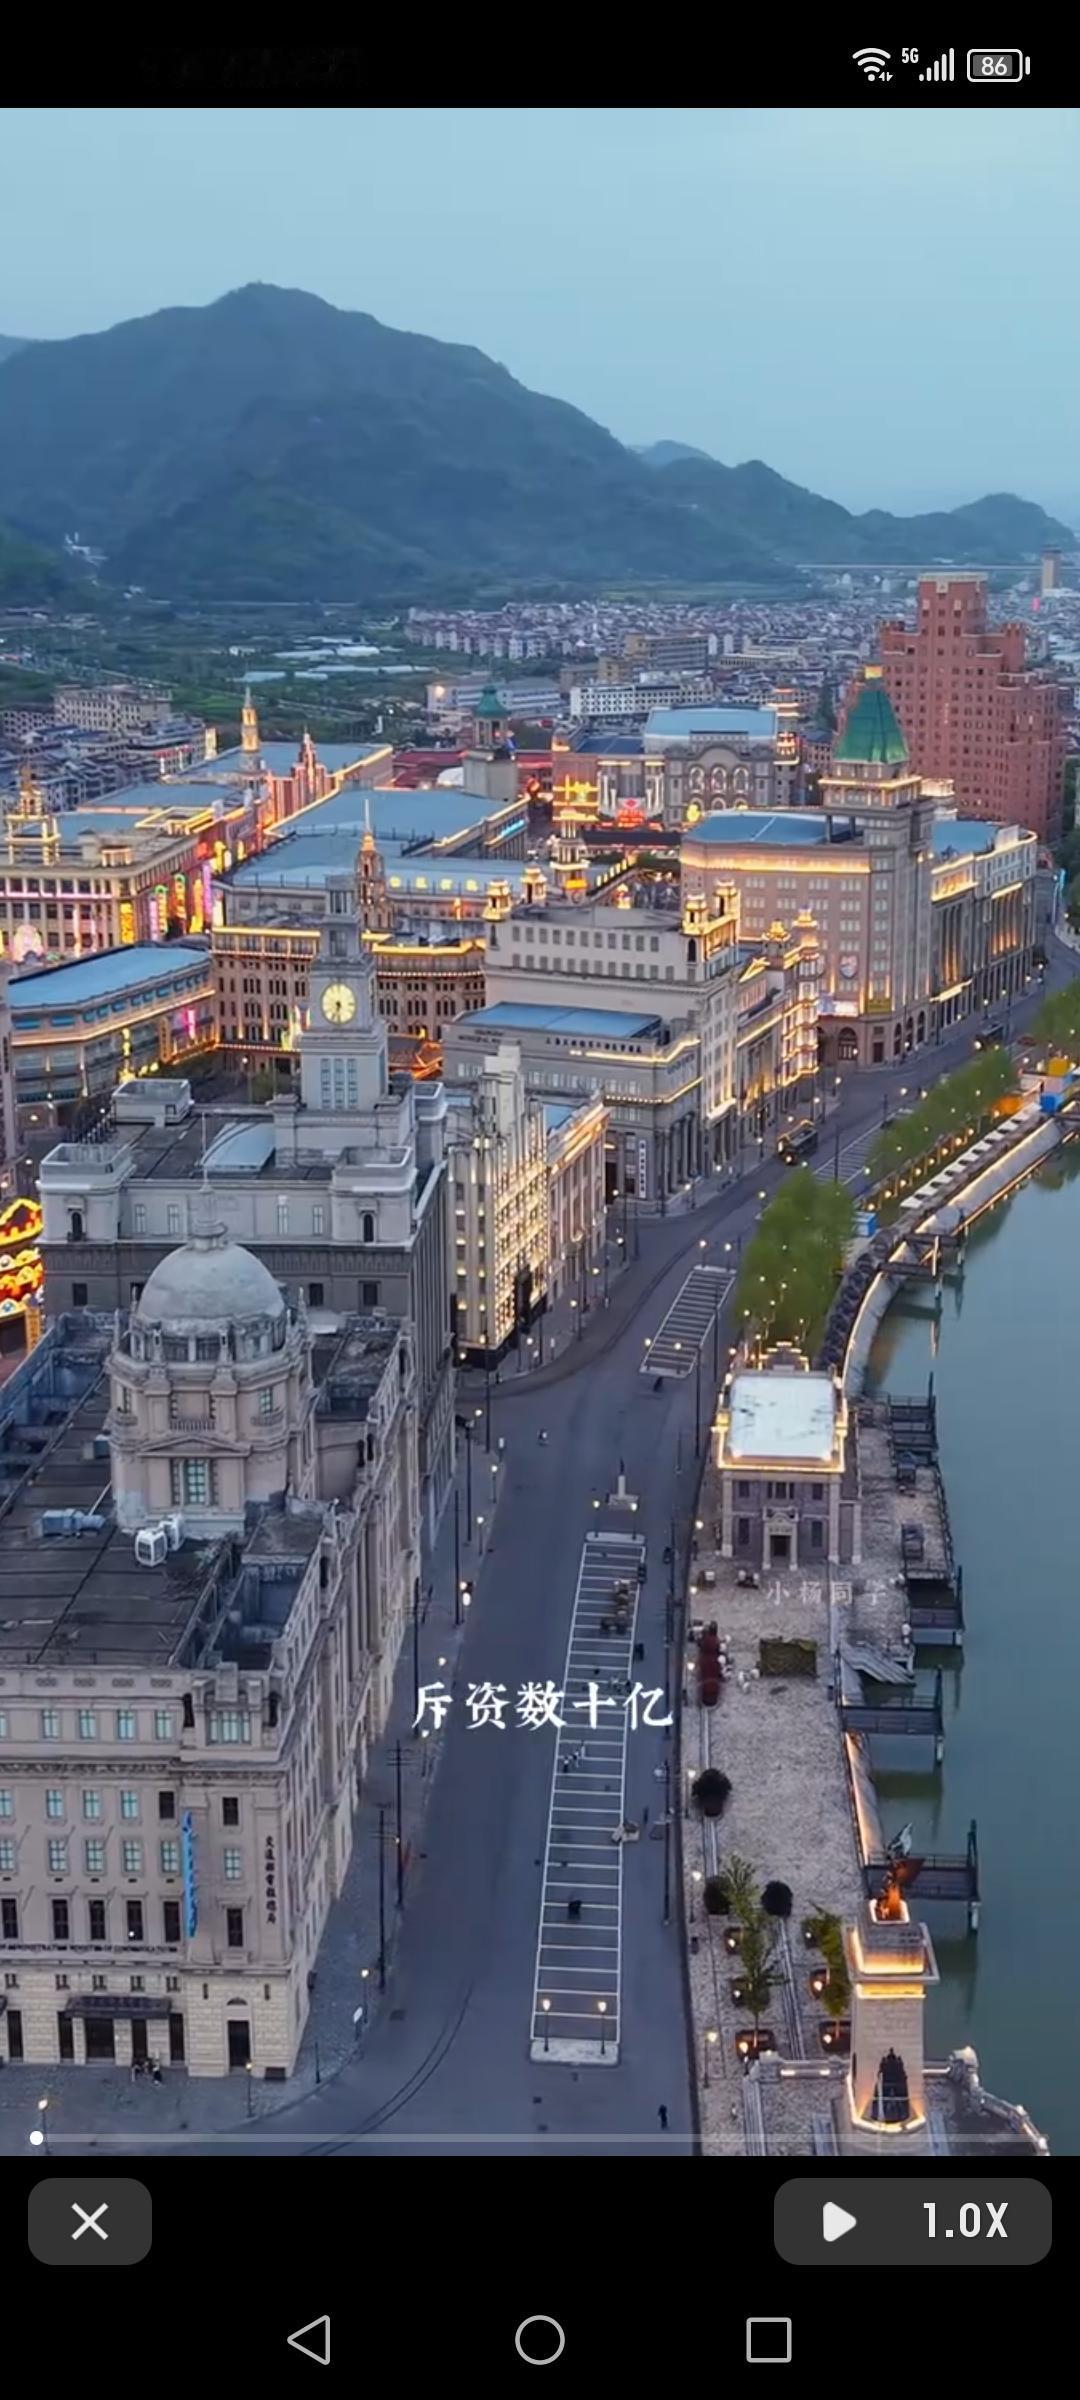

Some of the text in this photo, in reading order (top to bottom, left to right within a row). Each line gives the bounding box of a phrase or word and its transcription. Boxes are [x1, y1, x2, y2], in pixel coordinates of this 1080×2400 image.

[902, 48, 918, 63] 5G
[982, 57, 1007, 76] 86
[923, 2202, 1009, 2238] 1.0X
